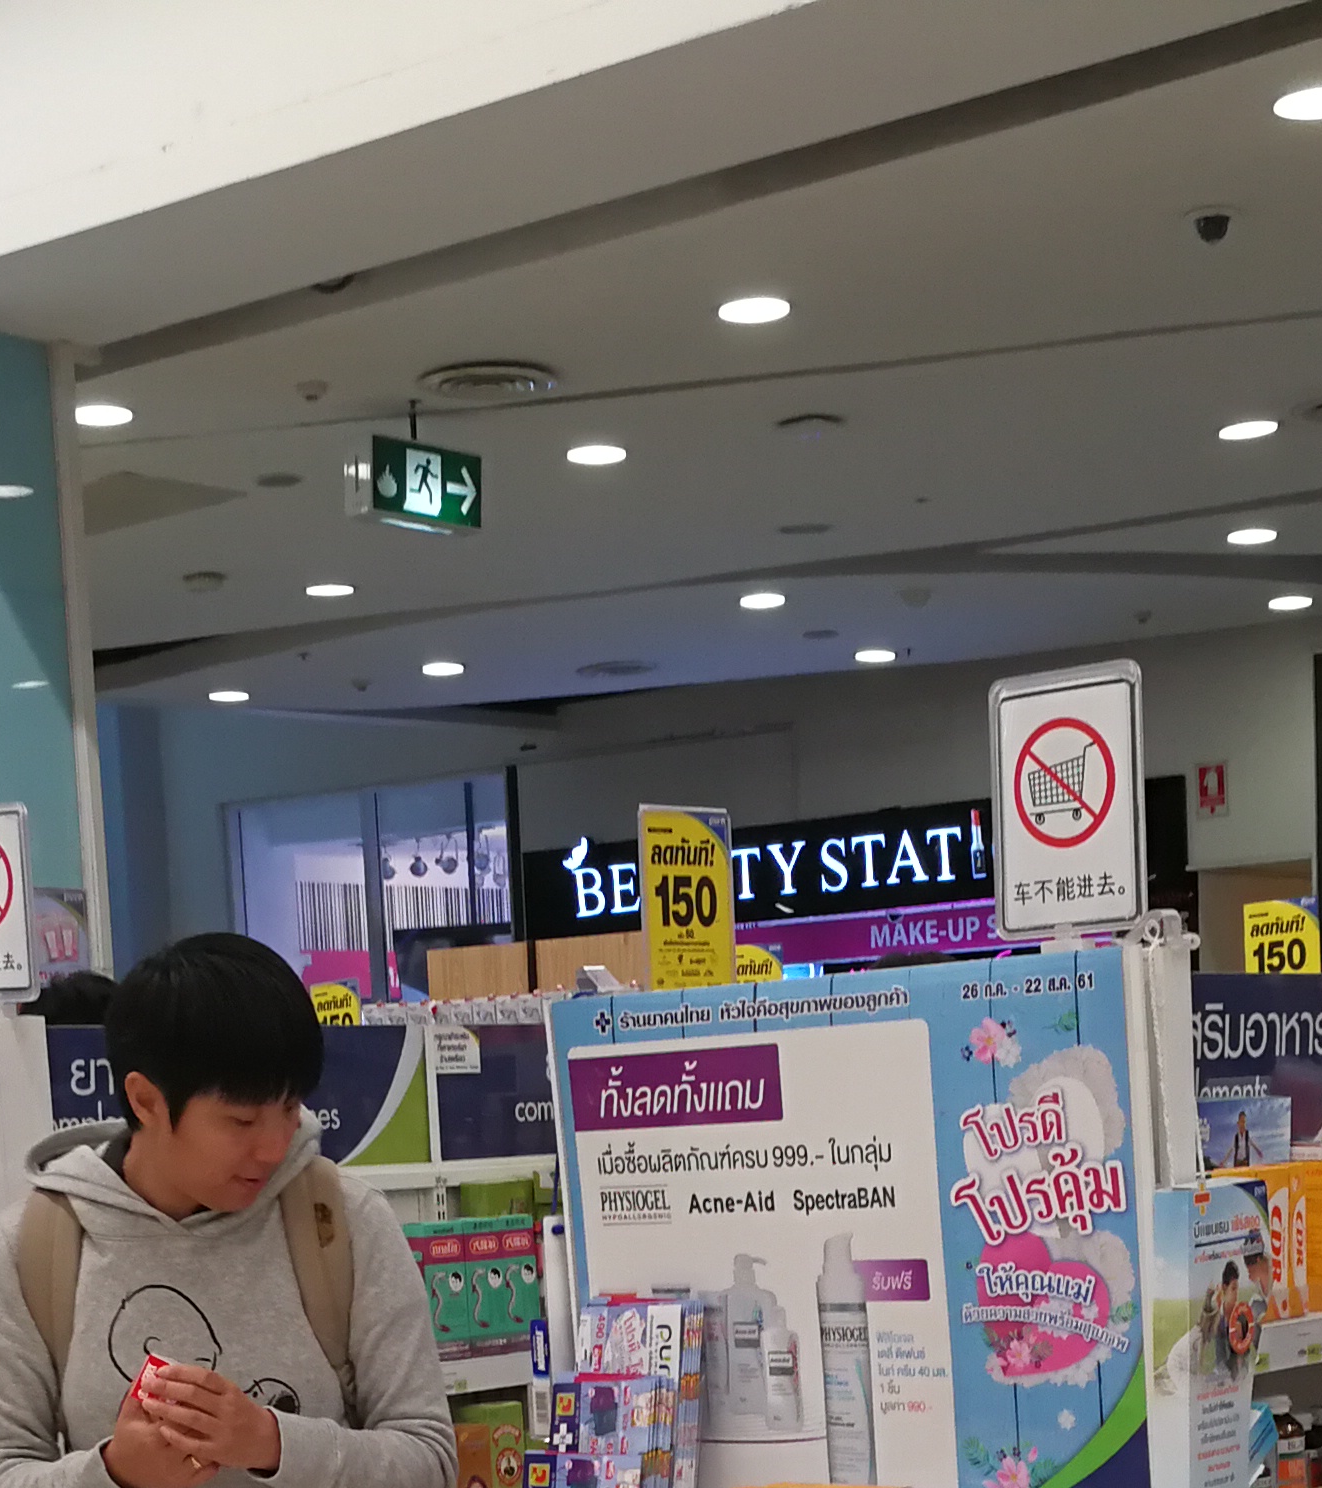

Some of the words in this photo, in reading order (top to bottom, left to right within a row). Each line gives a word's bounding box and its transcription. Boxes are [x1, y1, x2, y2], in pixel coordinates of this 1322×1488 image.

[573, 838, 808, 920] BETY
[654, 874, 717, 928] 150
[869, 918, 980, 949] MAKE-UP
[1251, 939, 1308, 974] 150
[961, 980, 979, 999] 26
[1024, 977, 1043, 996] 22
[1078, 973, 1094, 990] 61
[619, 1004, 711, 1031] ร้านยาคนไทย
[600, 1060, 765, 1119] ทั้งลดทั้งแถม
[961, 1091, 1063, 1158] โปรดี
[600, 1189, 671, 1213] PHYSIOGEL
[688, 1190, 775, 1215] Acne-Aid
[793, 1185, 896, 1215] SpectraBAN
[954, 1148, 1122, 1242] โปรคุ้ม
[871, 1270, 913, 1292] รับฟรี
